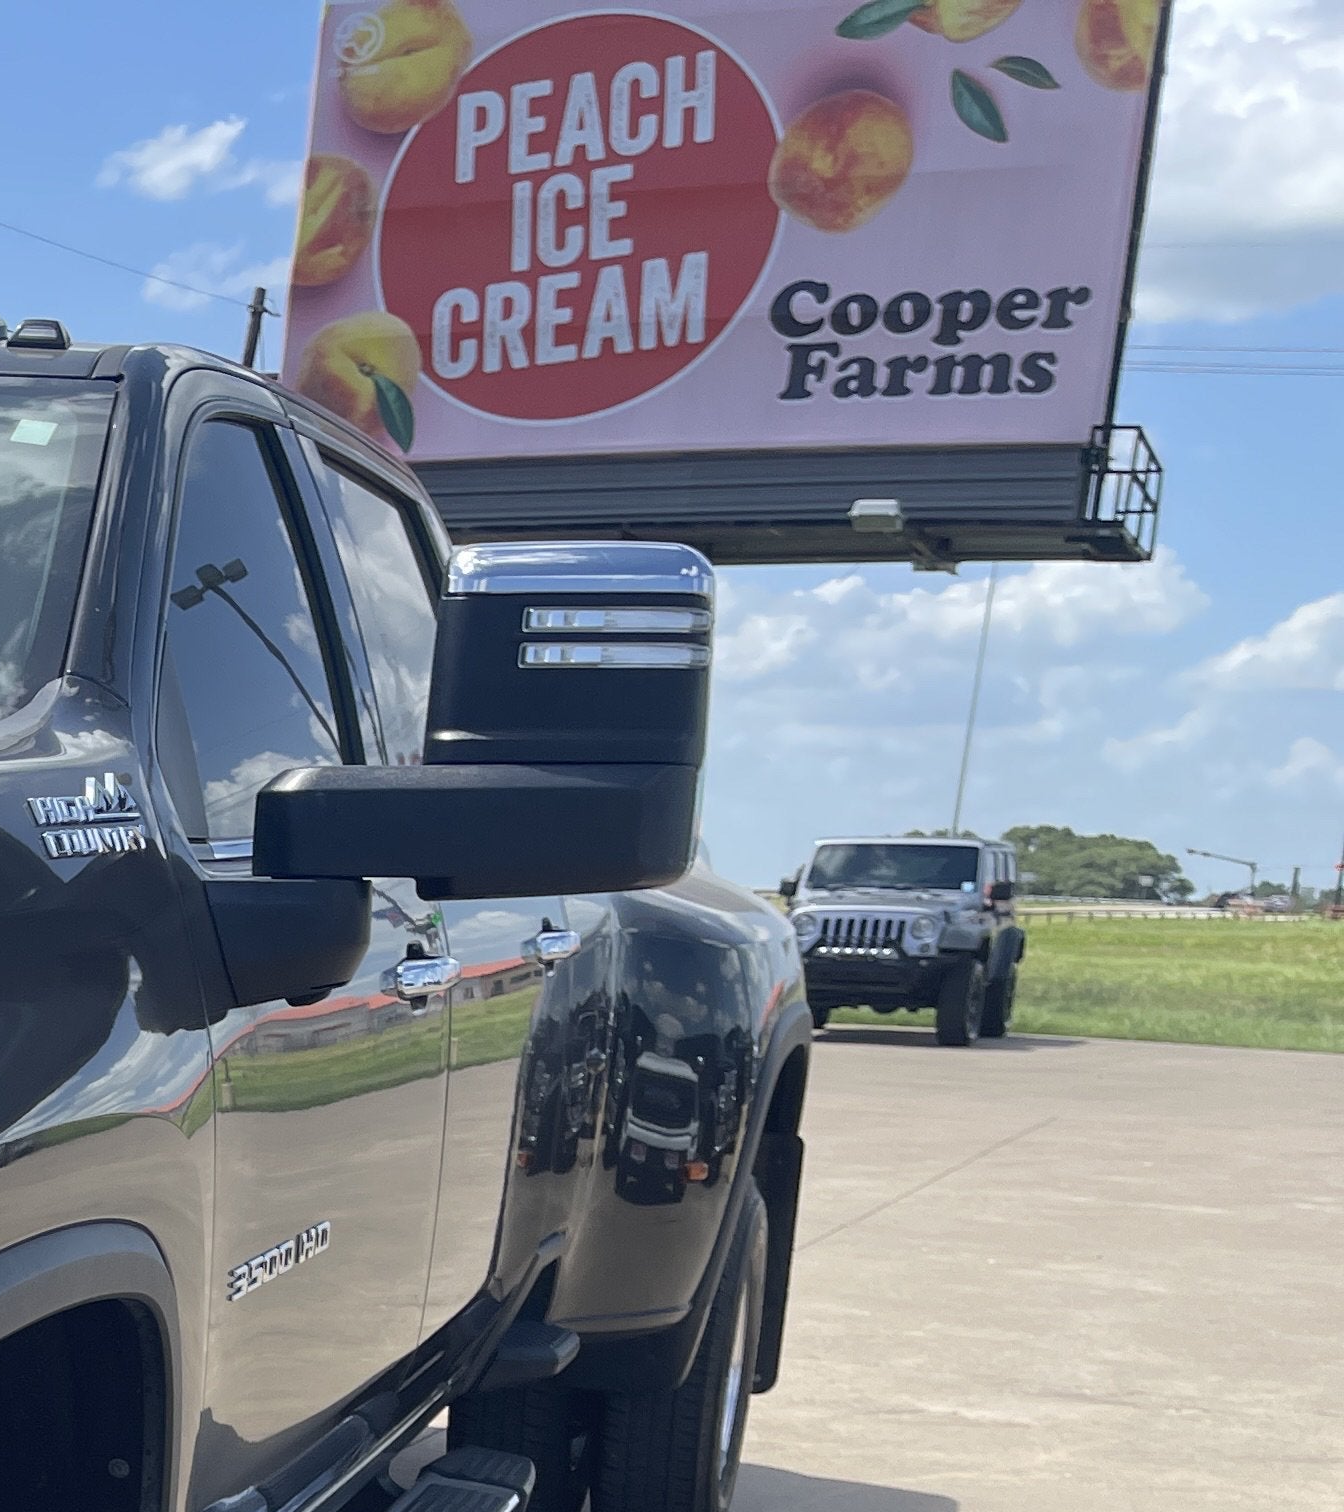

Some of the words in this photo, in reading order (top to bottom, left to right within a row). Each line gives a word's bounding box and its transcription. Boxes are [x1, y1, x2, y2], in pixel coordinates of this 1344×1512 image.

[455, 50, 716, 184] PEACH
[511, 165, 633, 273] ICE
[431, 251, 709, 380] CREAM
[769, 278, 1090, 346] Cooper
[778, 343, 1058, 401] Farms
[226, 1239, 295, 1302] 3500
[295, 1220, 331, 1264] HD
